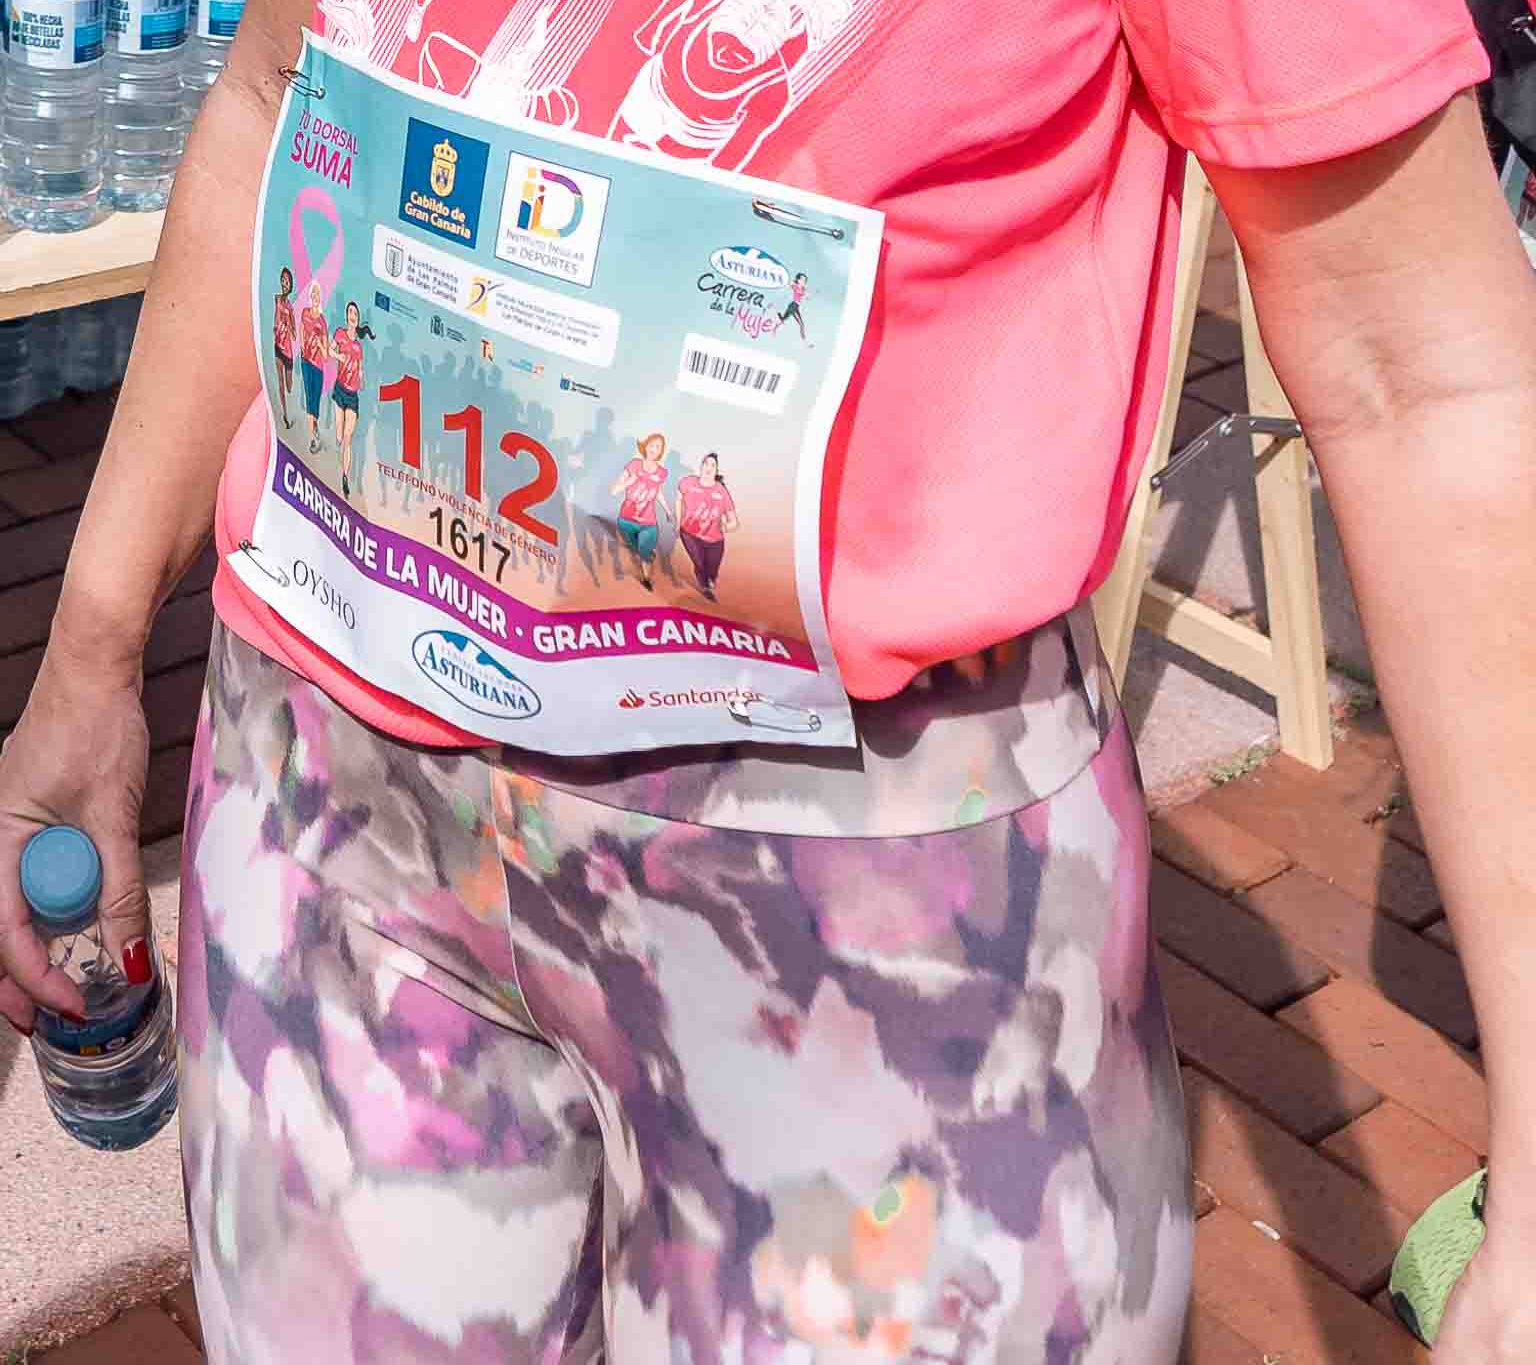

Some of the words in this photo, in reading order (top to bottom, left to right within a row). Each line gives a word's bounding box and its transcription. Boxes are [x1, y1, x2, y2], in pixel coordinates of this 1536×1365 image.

[290, 132, 353, 190] SUMA
[312, 116, 359, 157] DORSAL
[404, 203, 430, 223] Gran
[431, 211, 472, 241] Canaria
[410, 191, 445, 217] Cabildo
[446, 203, 466, 223] de
[697, 272, 765, 309] Carrera
[379, 374, 559, 547] 112
[283, 461, 350, 550] CARRERA
[352, 530, 378, 569] DE
[386, 546, 420, 589] LA
[427, 564, 508, 639] MUJER
[533, 622, 627, 655] GRAN
[636, 619, 792, 662] CANARIA
[429, 506, 512, 585] 1617
[437, 490, 491, 528] VIOLENCIA
[509, 532, 557, 566] GÉNERO
[293, 559, 356, 630] OYSHO
[422, 642, 532, 712] ASTURIANA
